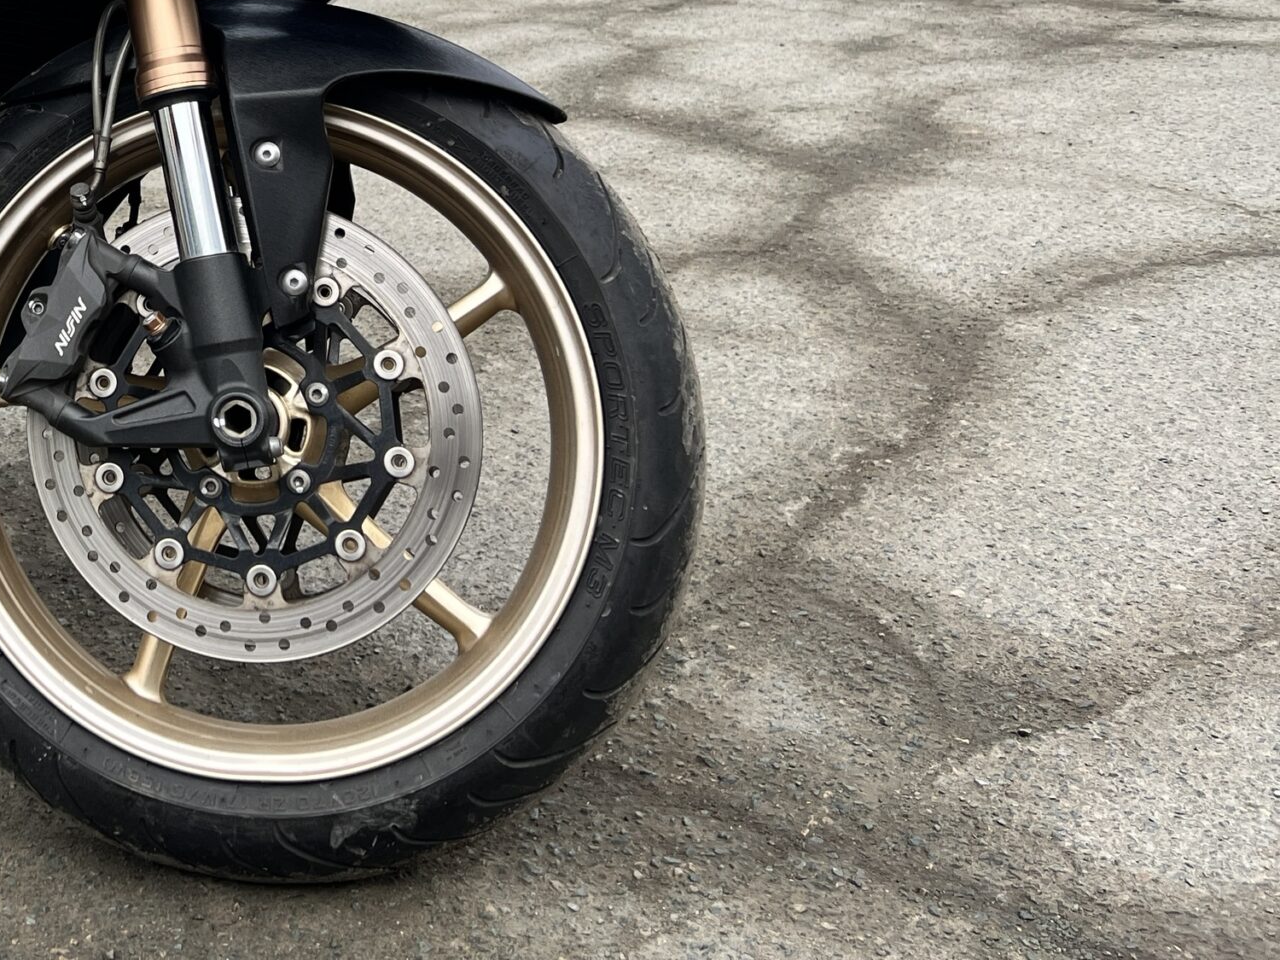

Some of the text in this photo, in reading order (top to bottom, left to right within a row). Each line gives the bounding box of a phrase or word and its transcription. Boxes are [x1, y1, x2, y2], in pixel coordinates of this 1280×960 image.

[54, 296, 87, 357] NISSIN
[580, 302, 632, 600] SPORTEC M3
